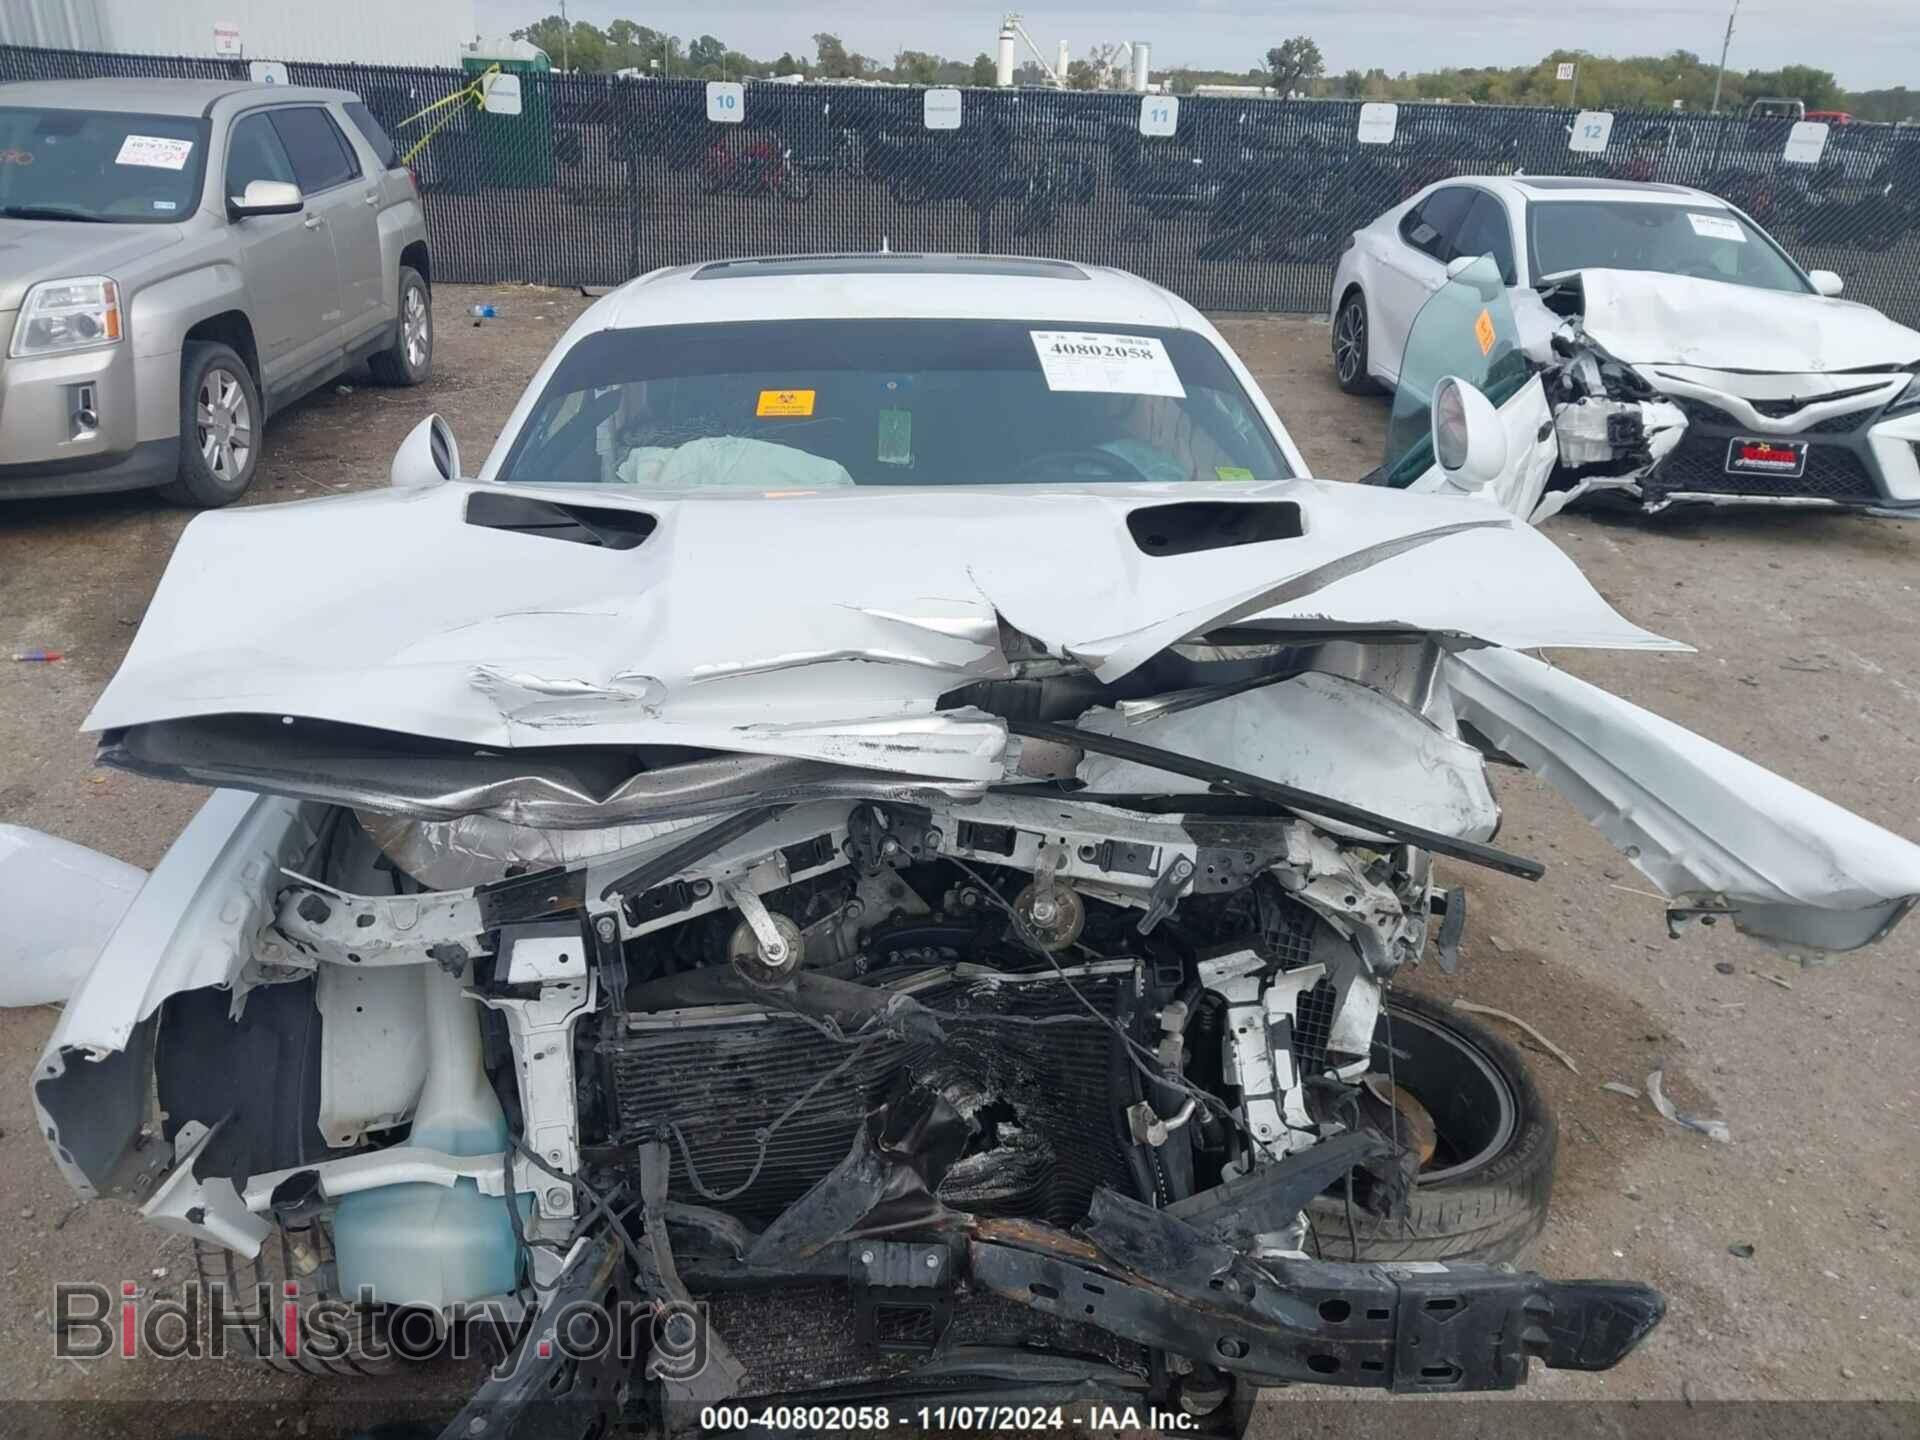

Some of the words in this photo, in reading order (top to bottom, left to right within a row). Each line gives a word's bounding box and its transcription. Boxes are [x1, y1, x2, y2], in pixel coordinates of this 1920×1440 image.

[716, 95, 735, 109] 10
[1152, 109, 1168, 122] 11
[1584, 125, 1602, 138] 12
[1050, 343, 1154, 360] 40802058
